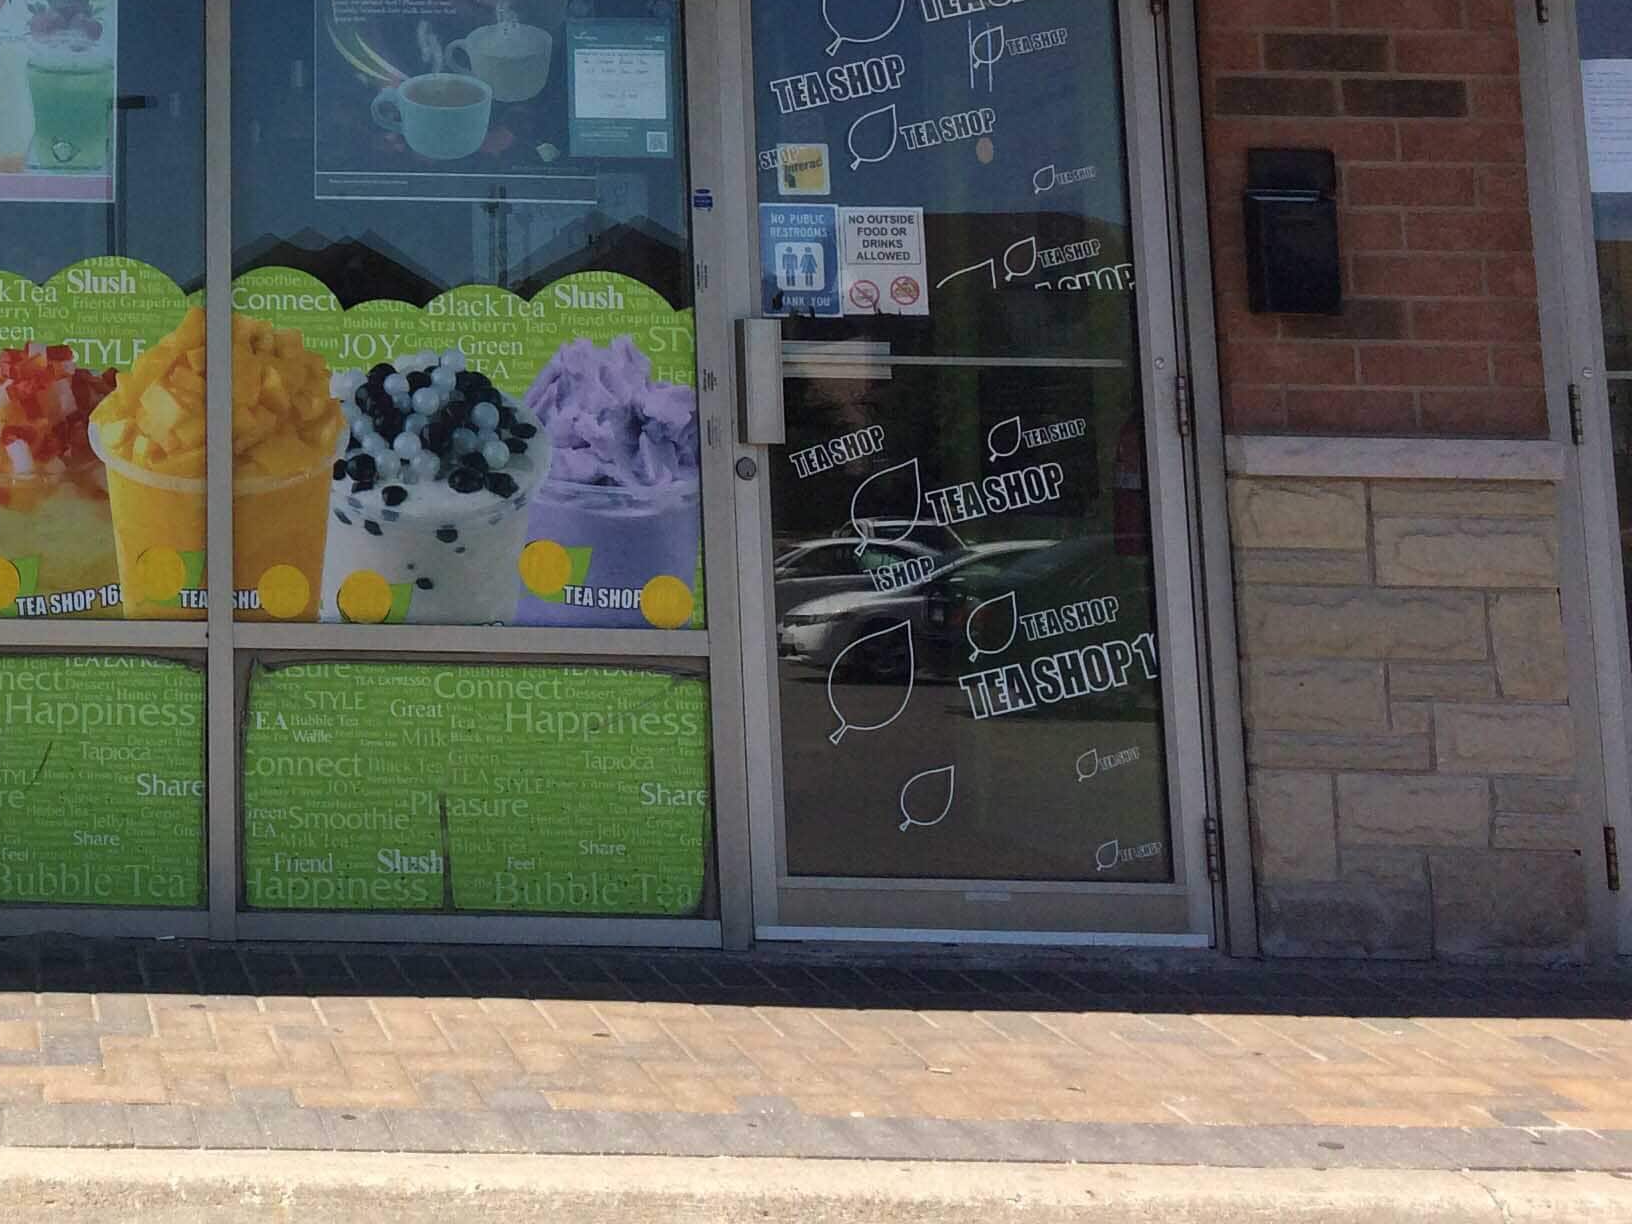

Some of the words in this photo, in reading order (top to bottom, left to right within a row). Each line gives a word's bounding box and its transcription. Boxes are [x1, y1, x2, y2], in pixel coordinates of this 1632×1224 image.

[1005, 38, 1033, 57] TEA
[1032, 27, 1068, 50] SHOP
[770, 73, 830, 114] TEA
[825, 54, 905, 103] SHOP
[899, 118, 943, 151] TEA
[941, 107, 998, 142] SHOP
[770, 225, 828, 237] RESTROOMS
[771, 213, 785, 225] NO
[790, 213, 825, 225] PUBLIC
[849, 214, 864, 225] NO
[866, 214, 915, 225] OUTSIDE
[857, 226, 881, 237] FOOD
[888, 226, 907, 237] OR
[856, 250, 912, 263] ALLOWED
[863, 238, 904, 250] DRINKS
[1036, 249, 1063, 269] TEA
[1062, 238, 1102, 262] SHOP
[13, 279, 59, 304] Tea
[66, 269, 137, 295] Slush
[231, 287, 337, 312] Connect
[427, 294, 498, 318] Black
[502, 294, 545, 318] Tea
[554, 283, 624, 311] Slush
[811, 296, 831, 307] YOU
[338, 332, 402, 361] JOY
[456, 334, 524, 357] Green
[1022, 429, 1049, 449] TEA
[1047, 419, 1087, 444] SHOP
[789, 449, 832, 479] TEA
[827, 425, 885, 465] SHOP
[925, 482, 987, 526] TEA
[983, 462, 1065, 514] SHOP
[15, 594, 48, 618] TEA
[48, 588, 98, 616] SHOP
[179, 589, 208, 610] TEA
[563, 585, 595, 608] TEA
[596, 587, 644, 610] SHOP
[1019, 610, 1056, 642] TEA
[1052, 596, 1120, 635] SHOP
[433, 671, 564, 700] Connect
[958, 668, 1036, 721] TEA
[1030, 640, 1133, 705] SHOP
[303, 690, 367, 711] STYLE
[389, 697, 443, 718] Great
[4, 693, 197, 734] Happiness
[505, 701, 698, 742] Happiness
[77, 741, 152, 765] Tapioca
[580, 749, 655, 774] Tapioca
[135, 773, 206, 797] Share
[639, 781, 706, 807] Share
[288, 805, 411, 831] Smoothie
[72, 829, 121, 847] Share
[577, 839, 627, 857] Share
[273, 851, 334, 875] Friend
[375, 847, 444, 875] Slush
[506, 856, 536, 872] Feel
[124, 863, 186, 898] Tea
[494, 872, 619, 906] Bubble
[631, 874, 701, 907] Tea
